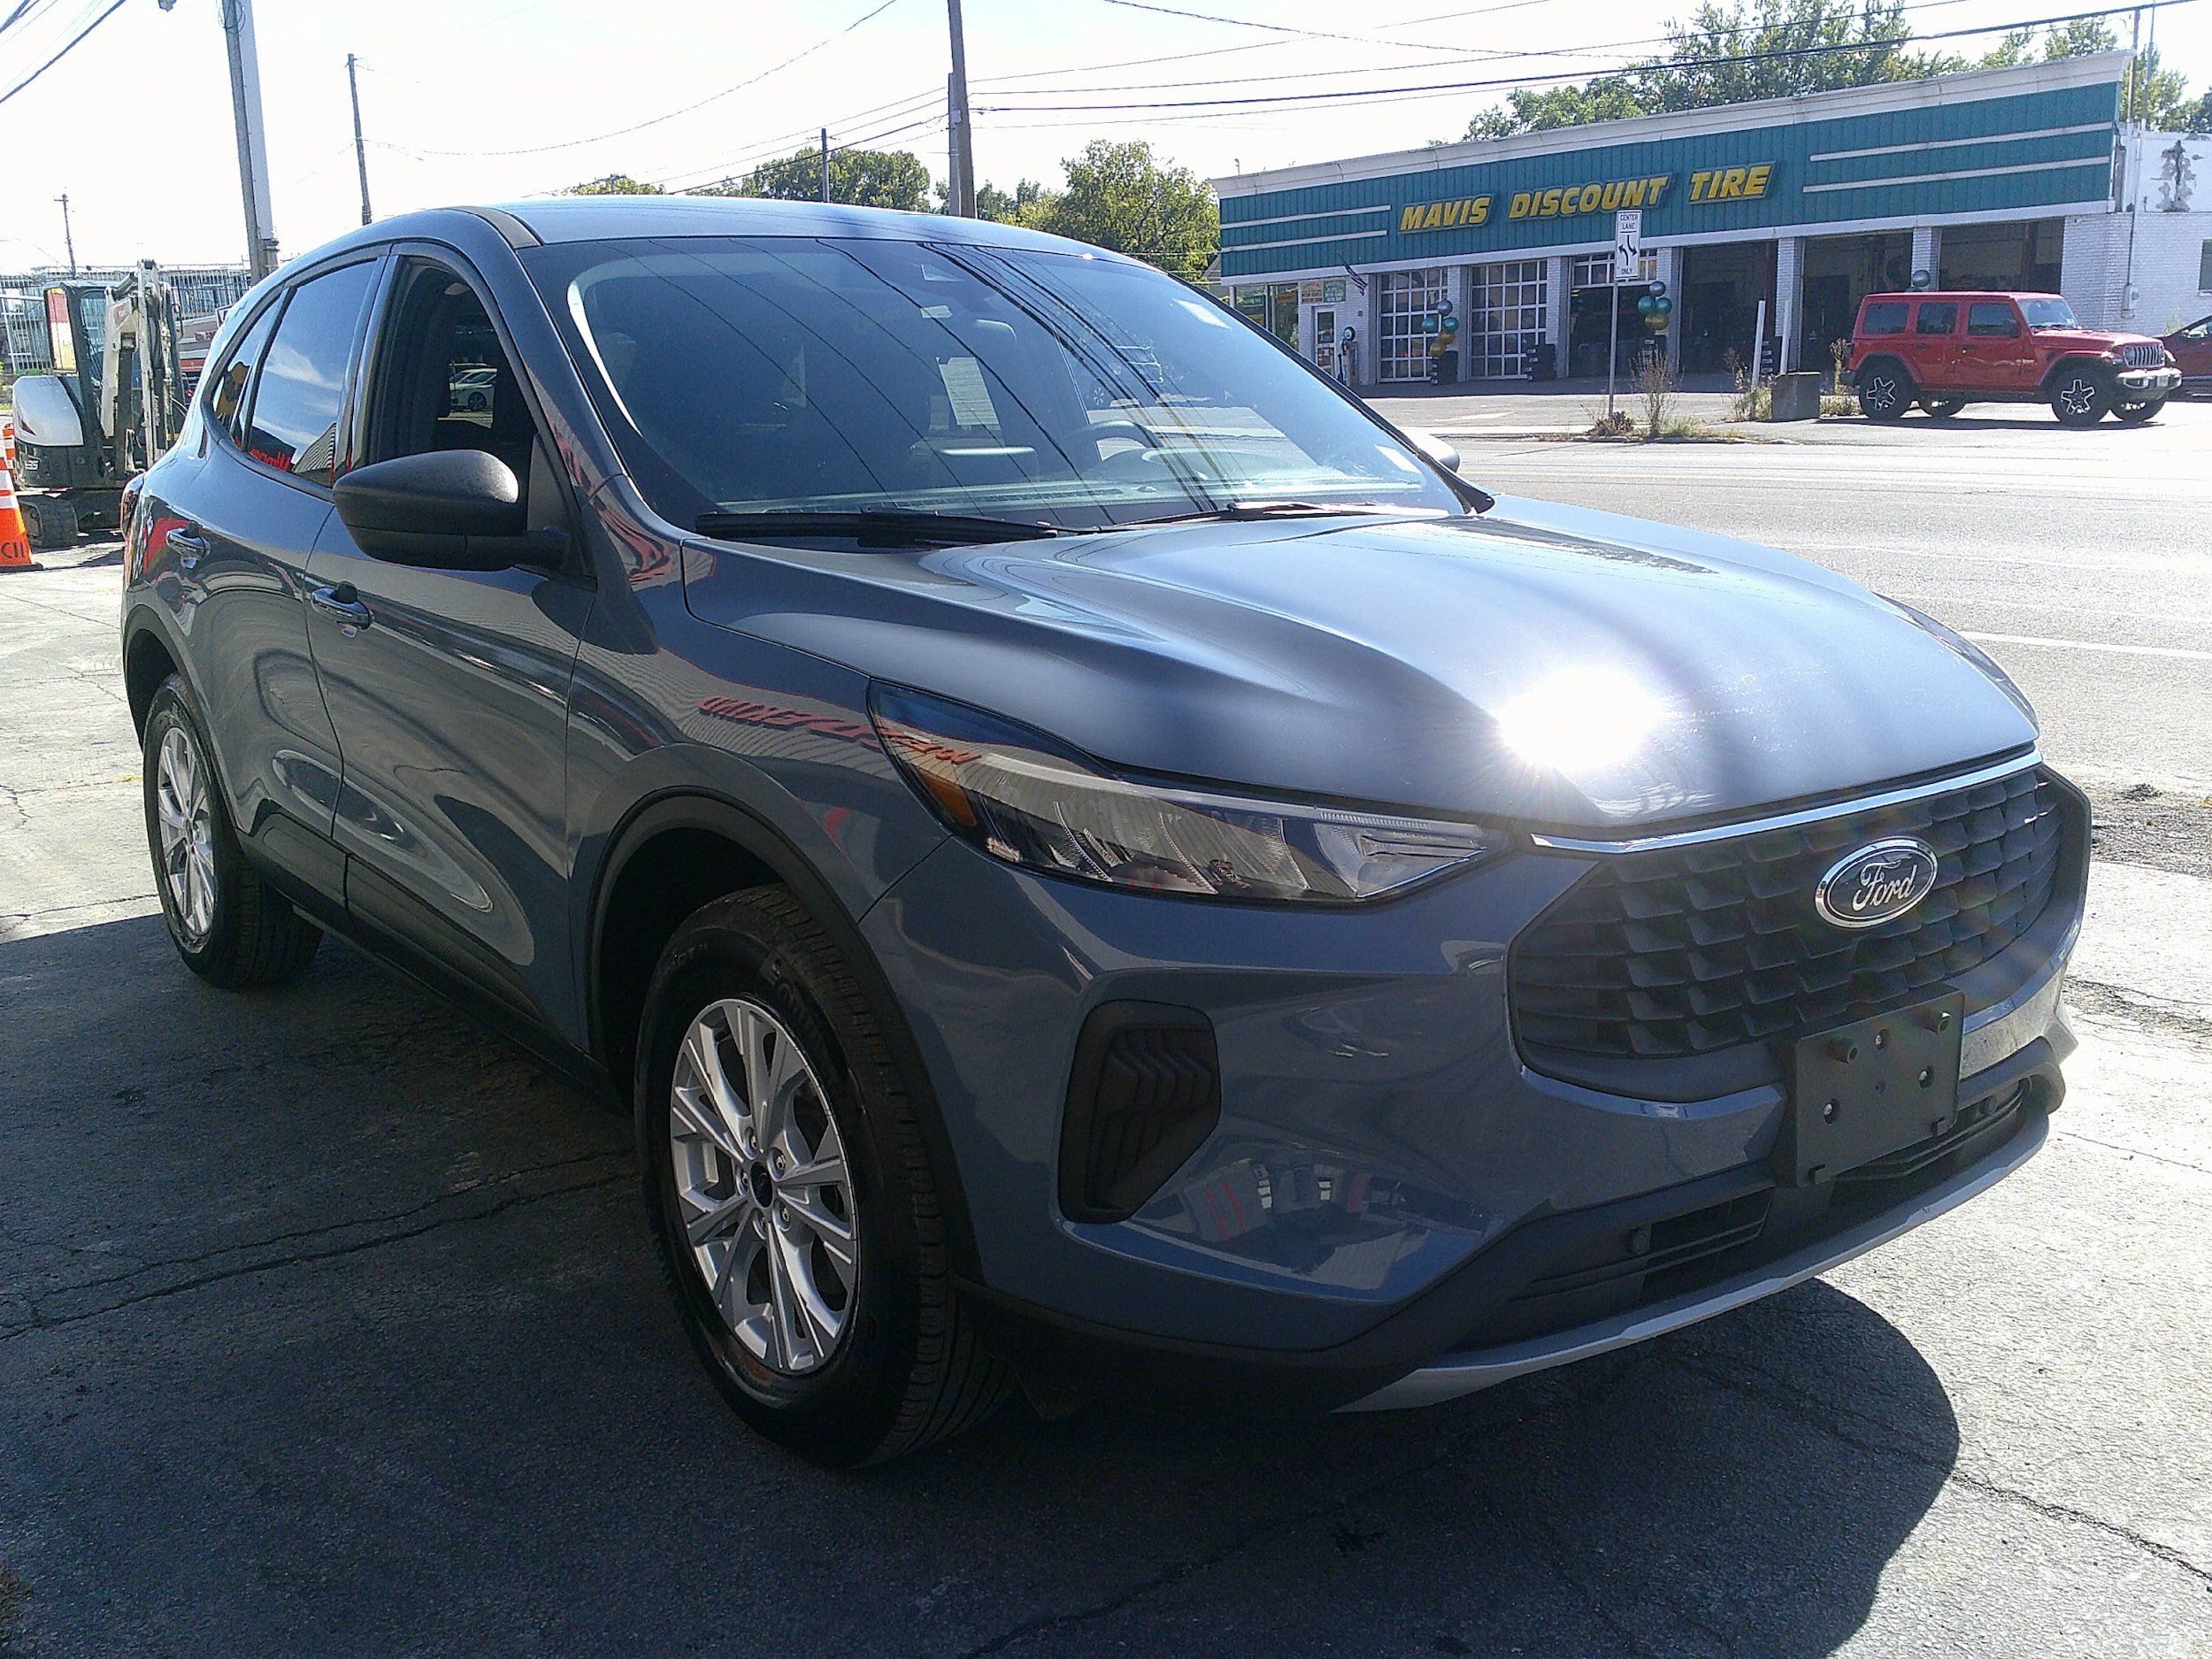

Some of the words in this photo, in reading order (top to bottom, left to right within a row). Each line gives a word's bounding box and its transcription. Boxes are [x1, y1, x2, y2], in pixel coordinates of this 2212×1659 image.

[1400, 196, 1491, 231] MAVIS
[1508, 176, 1669, 219] DISCOUNT
[1689, 165, 1771, 201] TIRE
[1852, 858, 1918, 911] Ford
